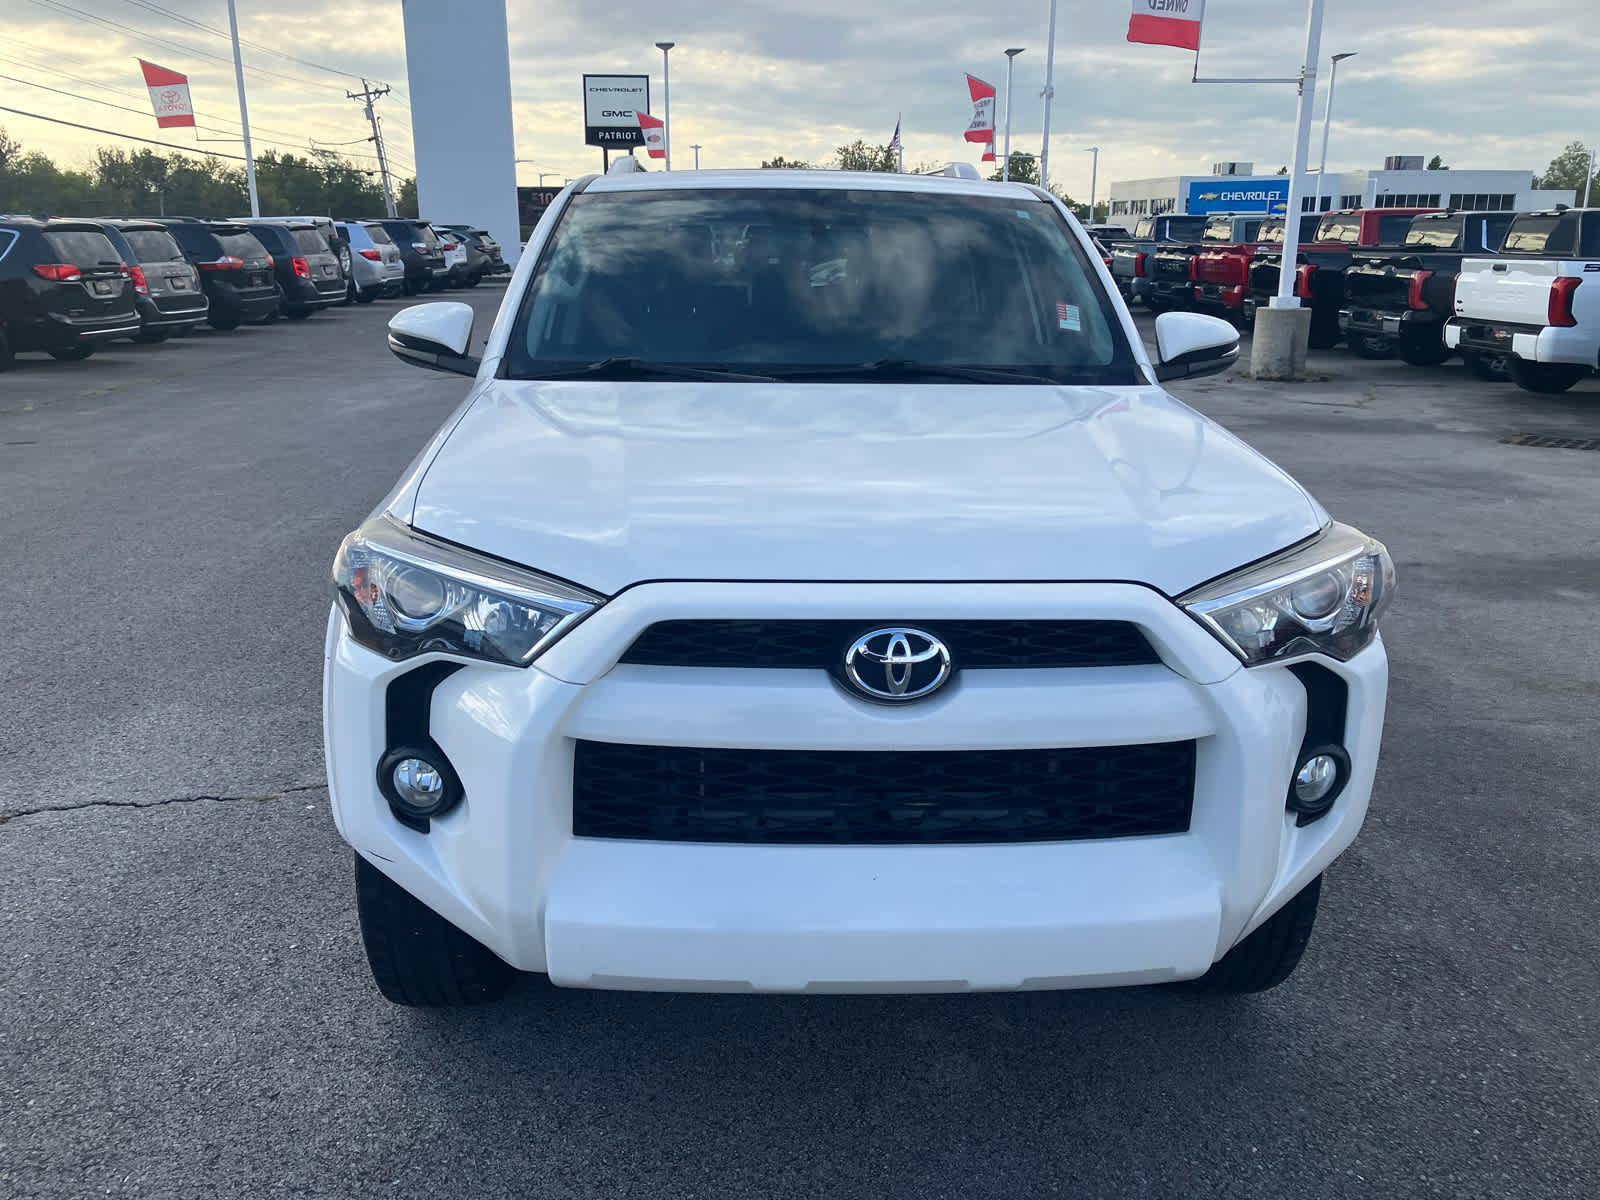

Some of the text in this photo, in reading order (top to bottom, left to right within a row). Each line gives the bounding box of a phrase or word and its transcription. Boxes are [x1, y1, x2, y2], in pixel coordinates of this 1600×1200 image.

[601, 110, 633, 118] GMC
[598, 131, 637, 140] PATRIOT
[1220, 190, 1281, 201] CHEVROLET
